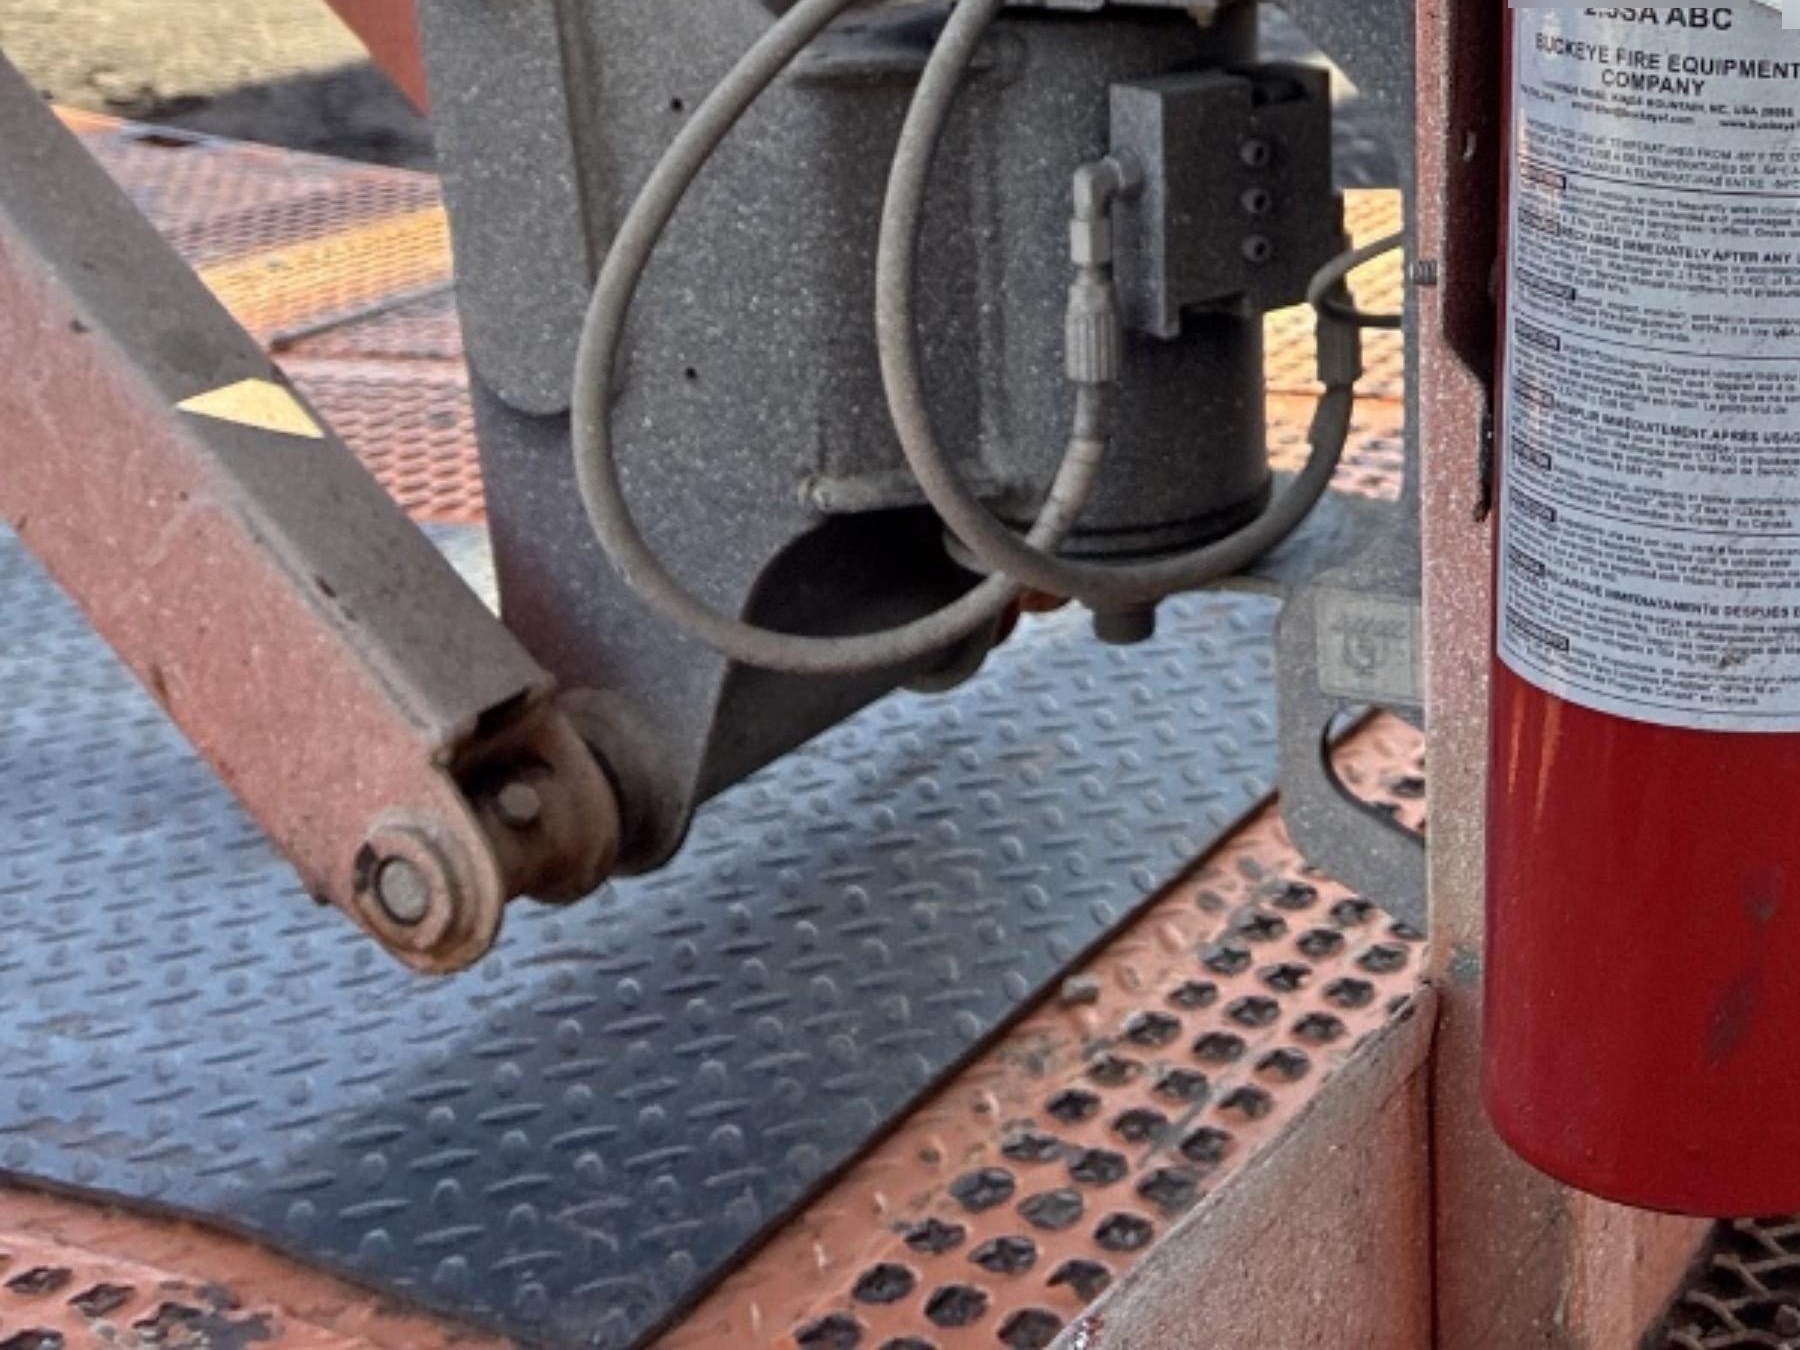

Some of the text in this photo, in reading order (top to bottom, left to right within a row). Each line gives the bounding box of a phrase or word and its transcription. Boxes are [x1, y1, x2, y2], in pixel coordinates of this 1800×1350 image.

[1665, 7, 1733, 31] ABC
[1535, 32, 1609, 64] BUCKEYE
[1616, 48, 1661, 69] FIRE
[1601, 67, 1705, 96] COMPANY
[1763, 252, 1791, 263] ANY
